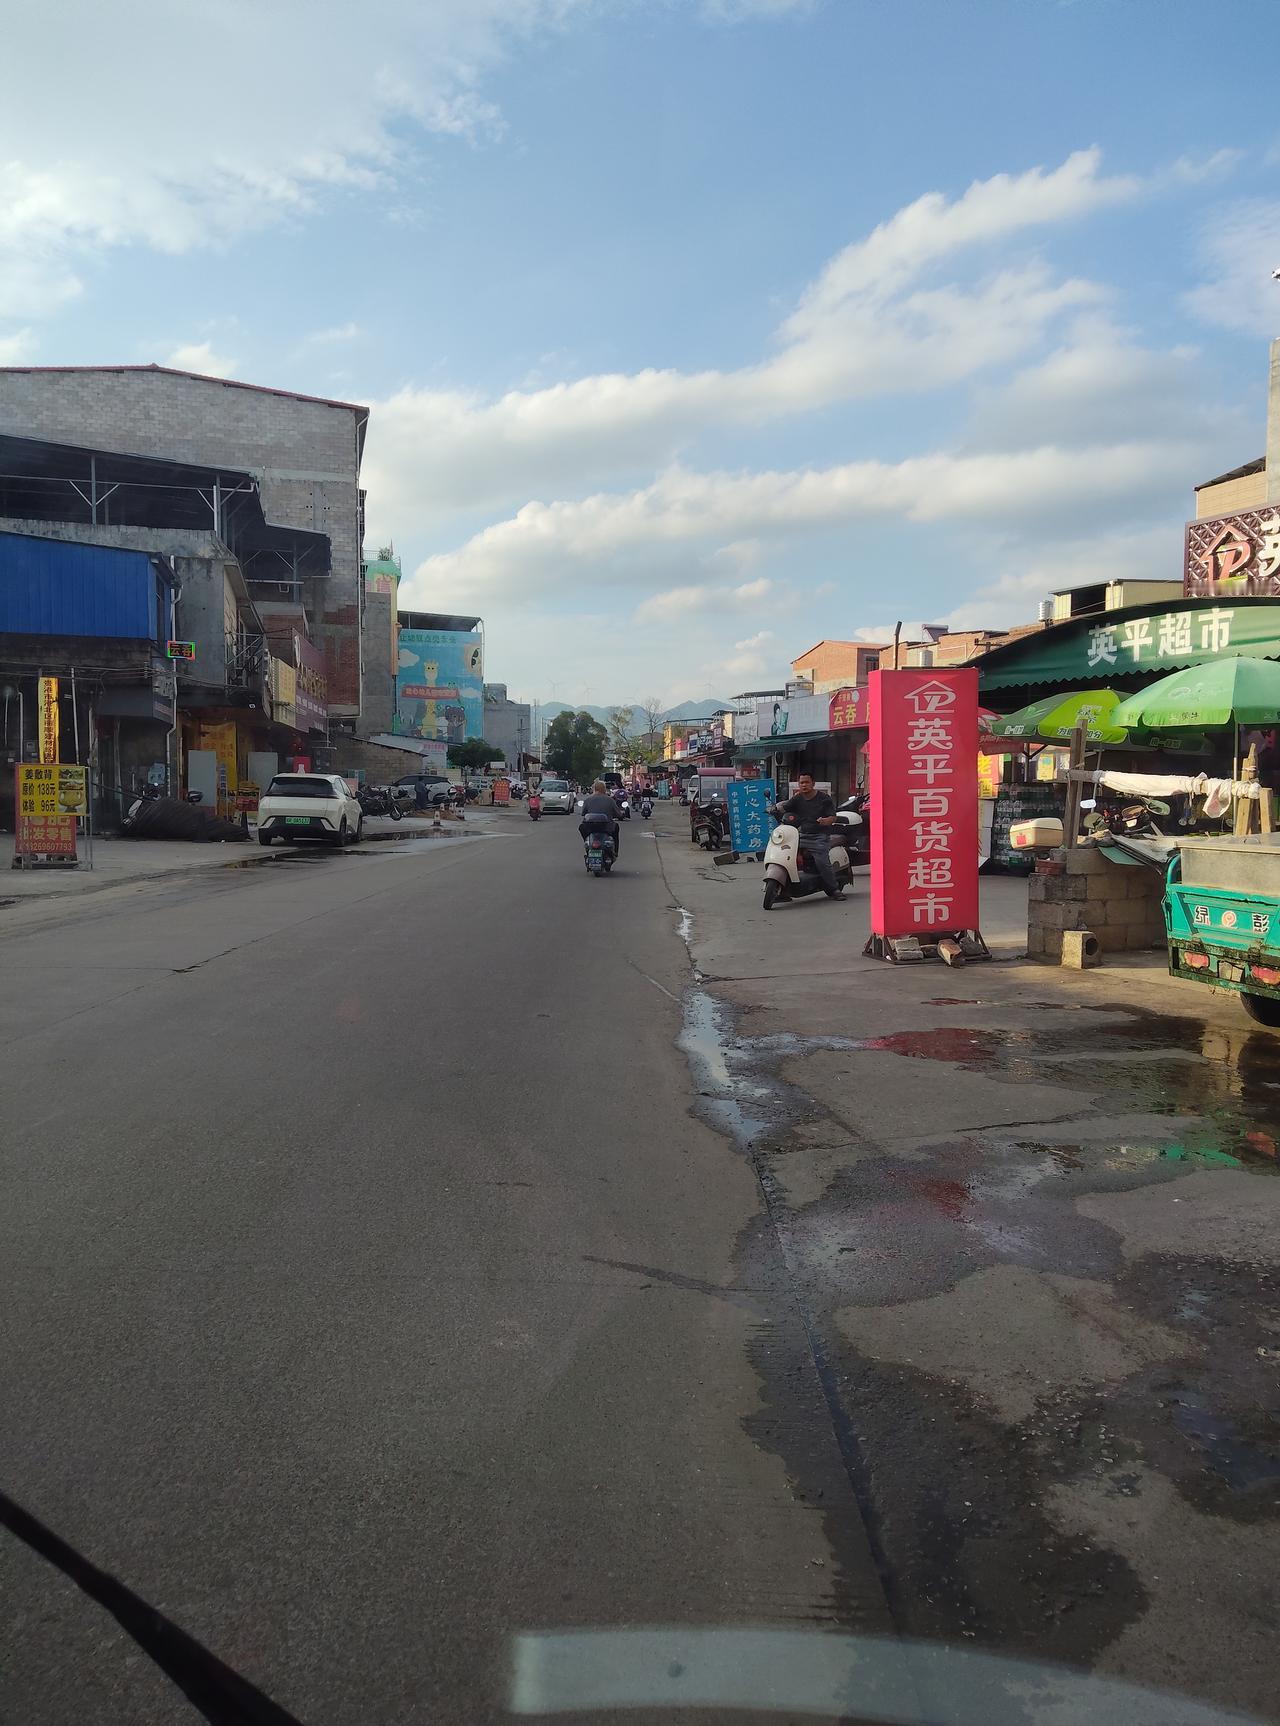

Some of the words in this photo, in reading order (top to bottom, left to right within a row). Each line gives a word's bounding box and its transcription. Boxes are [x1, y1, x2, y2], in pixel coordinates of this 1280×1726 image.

[1087, 607, 1235, 667] 英平超市
[833, 703, 857, 726] 云吞
[22, 783, 35, 796] 原价
[37, 783, 56, 796] 138元
[22, 800, 35, 813] 体验
[40, 800, 56, 813] 96元
[744, 784, 763, 848] 仁心大药房
[907, 718, 954, 924] 英平百货超市
